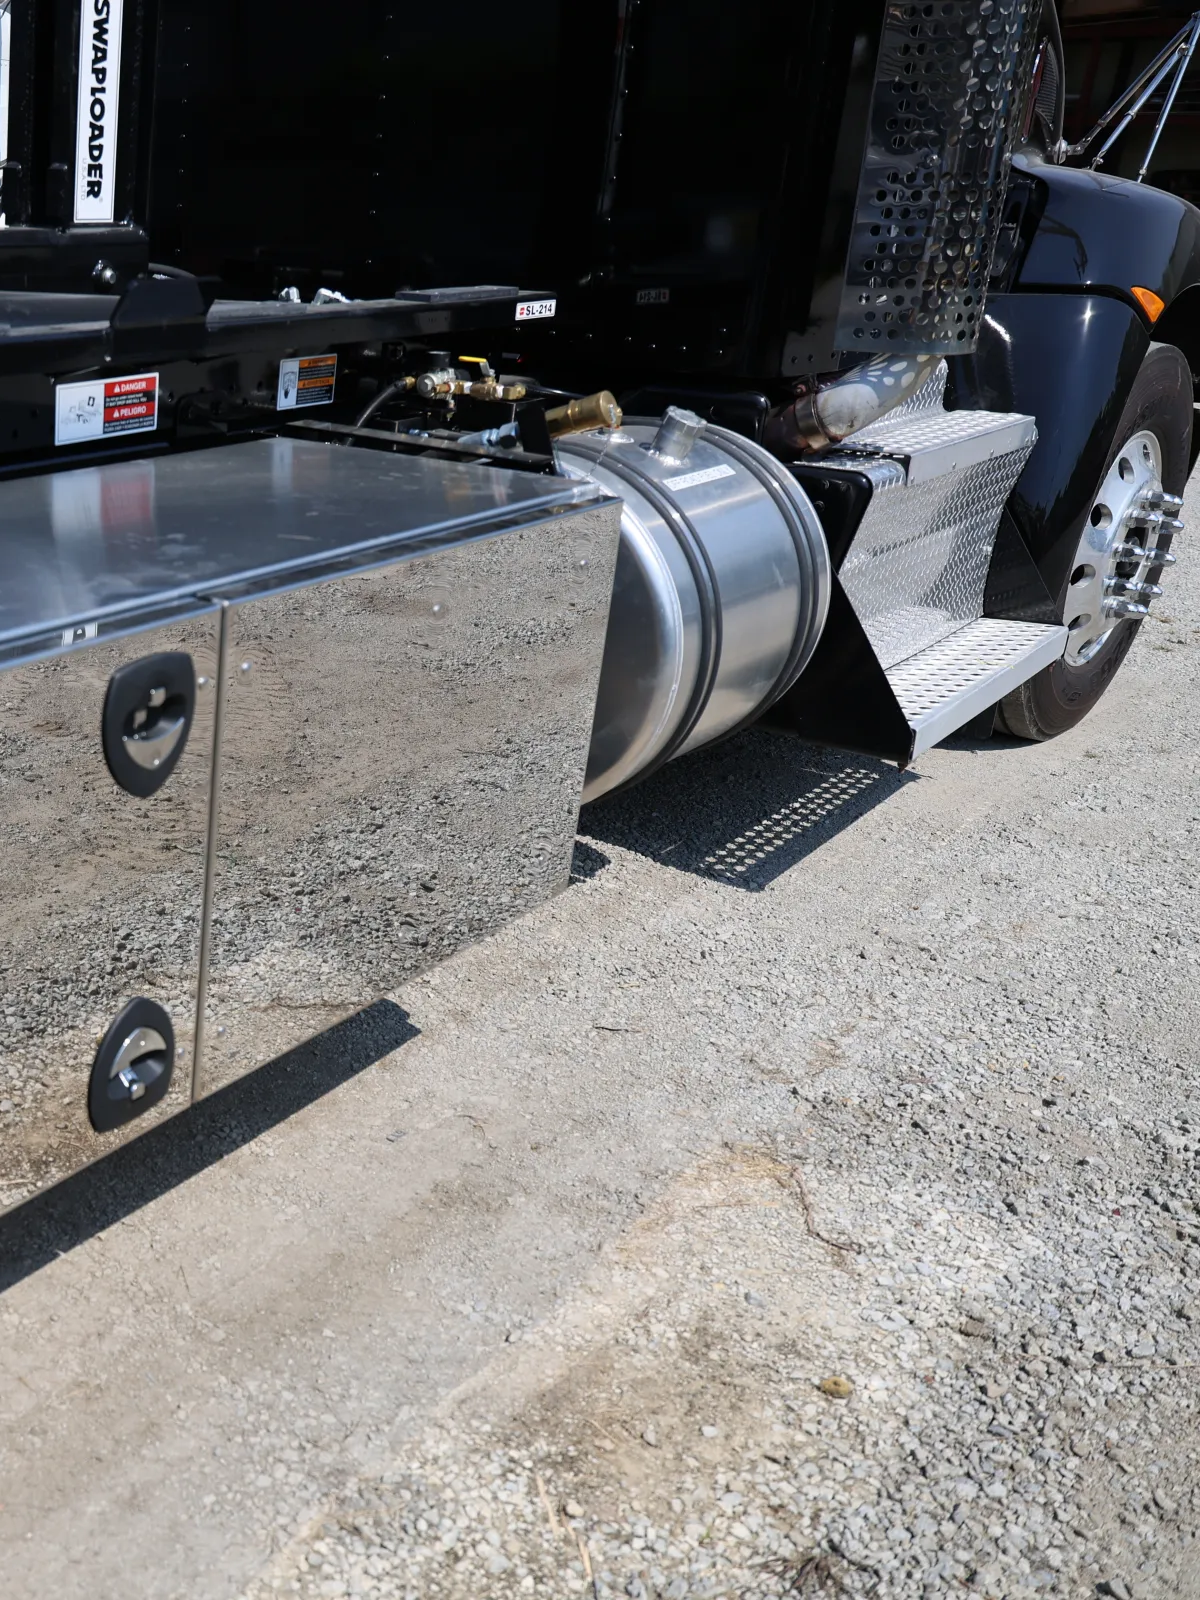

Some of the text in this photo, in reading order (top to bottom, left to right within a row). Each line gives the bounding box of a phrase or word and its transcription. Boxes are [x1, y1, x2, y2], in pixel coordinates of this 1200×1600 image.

[86, 0, 110, 199] SWAPLOADER
[525, 303, 553, 316] SL-214
[121, 381, 146, 392] DANGER
[120, 405, 146, 417] PELIGRO
